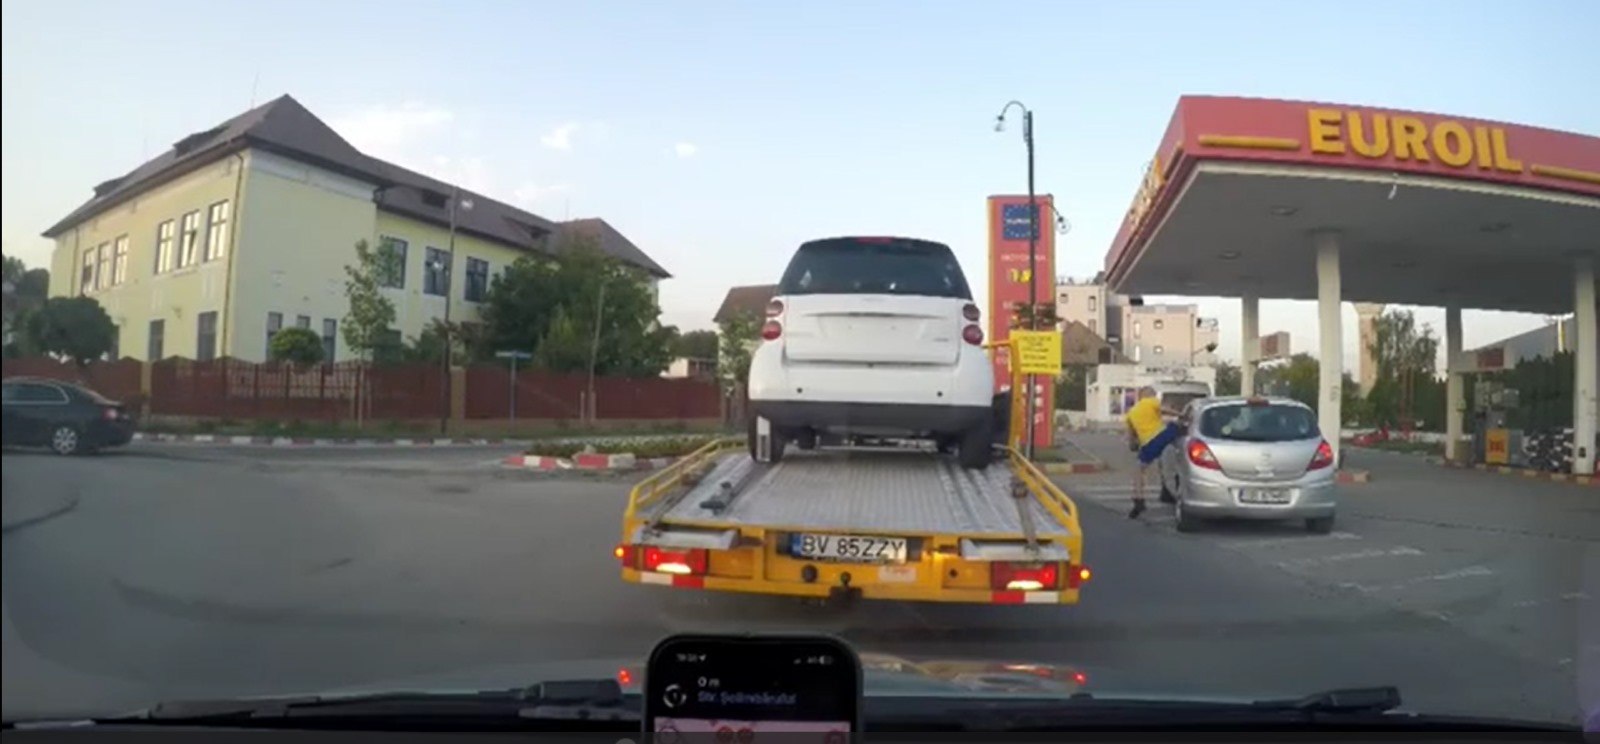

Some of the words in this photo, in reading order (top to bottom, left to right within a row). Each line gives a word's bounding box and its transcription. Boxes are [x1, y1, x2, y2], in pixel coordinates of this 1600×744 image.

[1308, 108, 1523, 172] EUROIL
[802, 535, 829, 554] BV
[836, 538, 903, 559] 85ZZY
